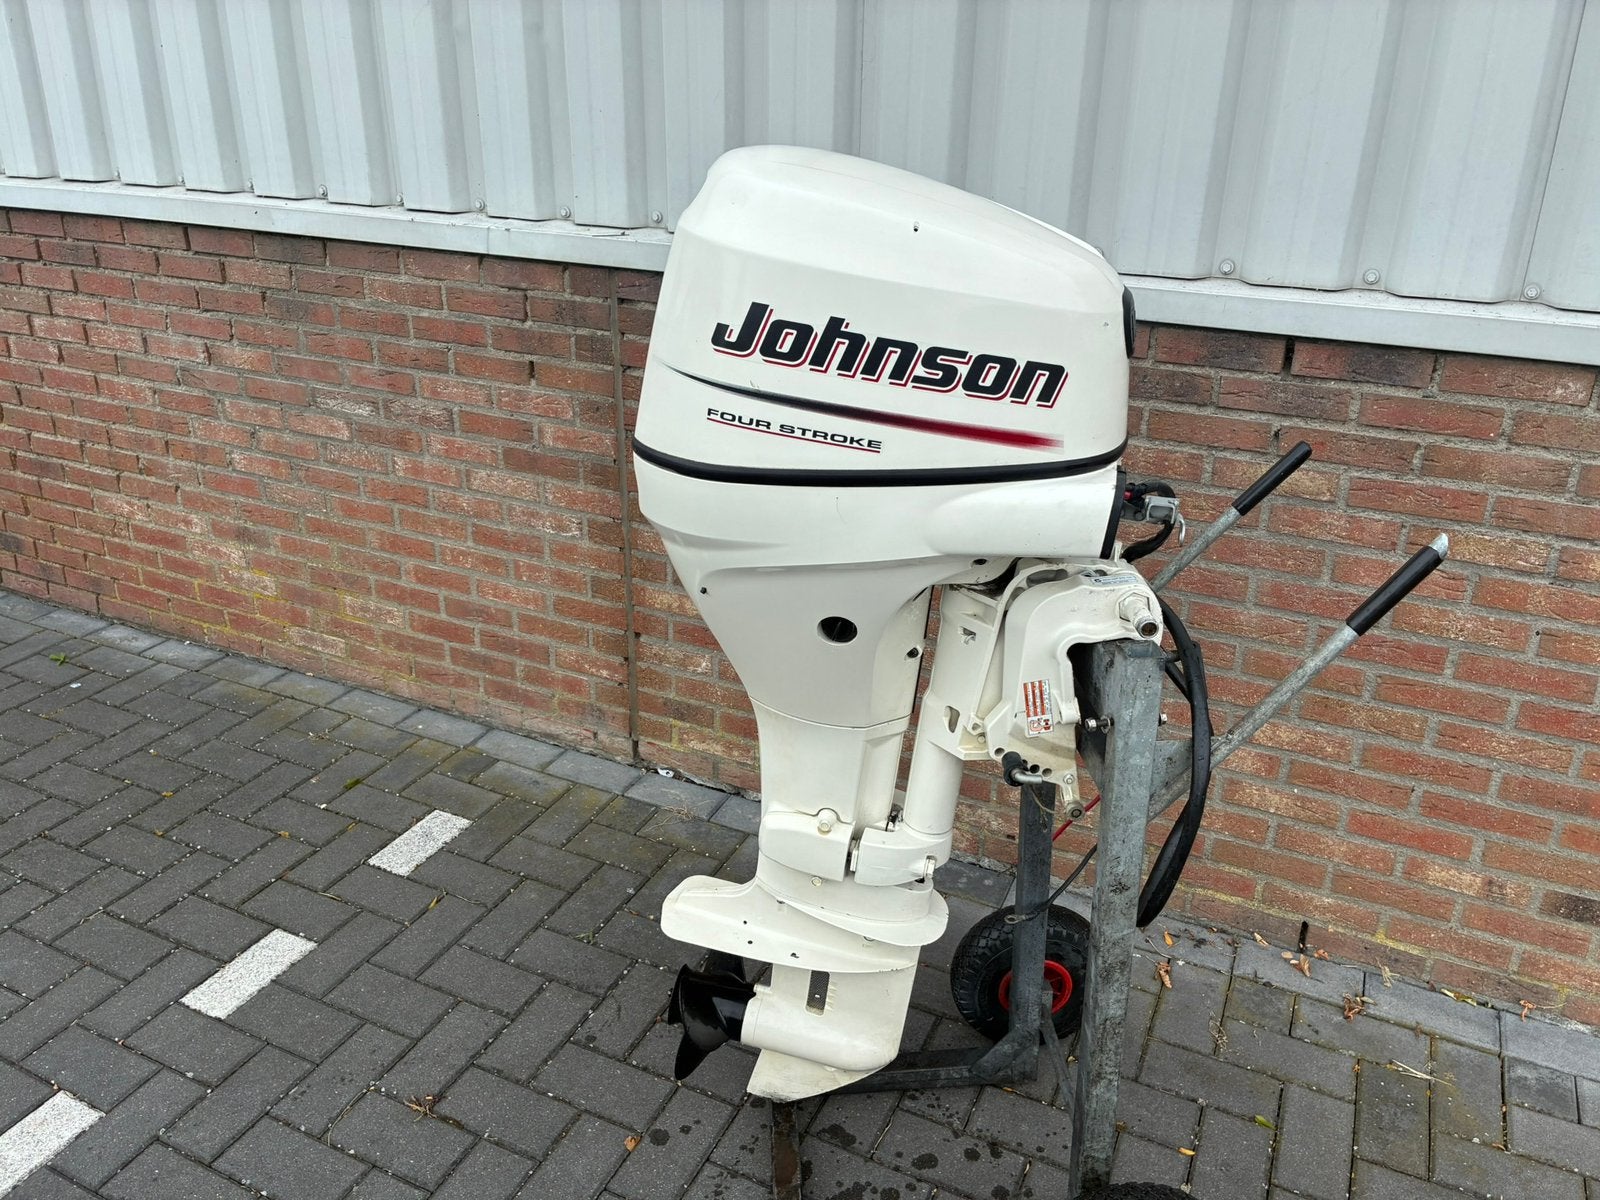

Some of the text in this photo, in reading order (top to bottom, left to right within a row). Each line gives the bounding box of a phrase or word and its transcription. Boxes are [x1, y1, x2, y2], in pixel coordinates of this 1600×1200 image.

[711, 301, 1068, 408] Johnson
[707, 408, 882, 449] FOUR STROKE
